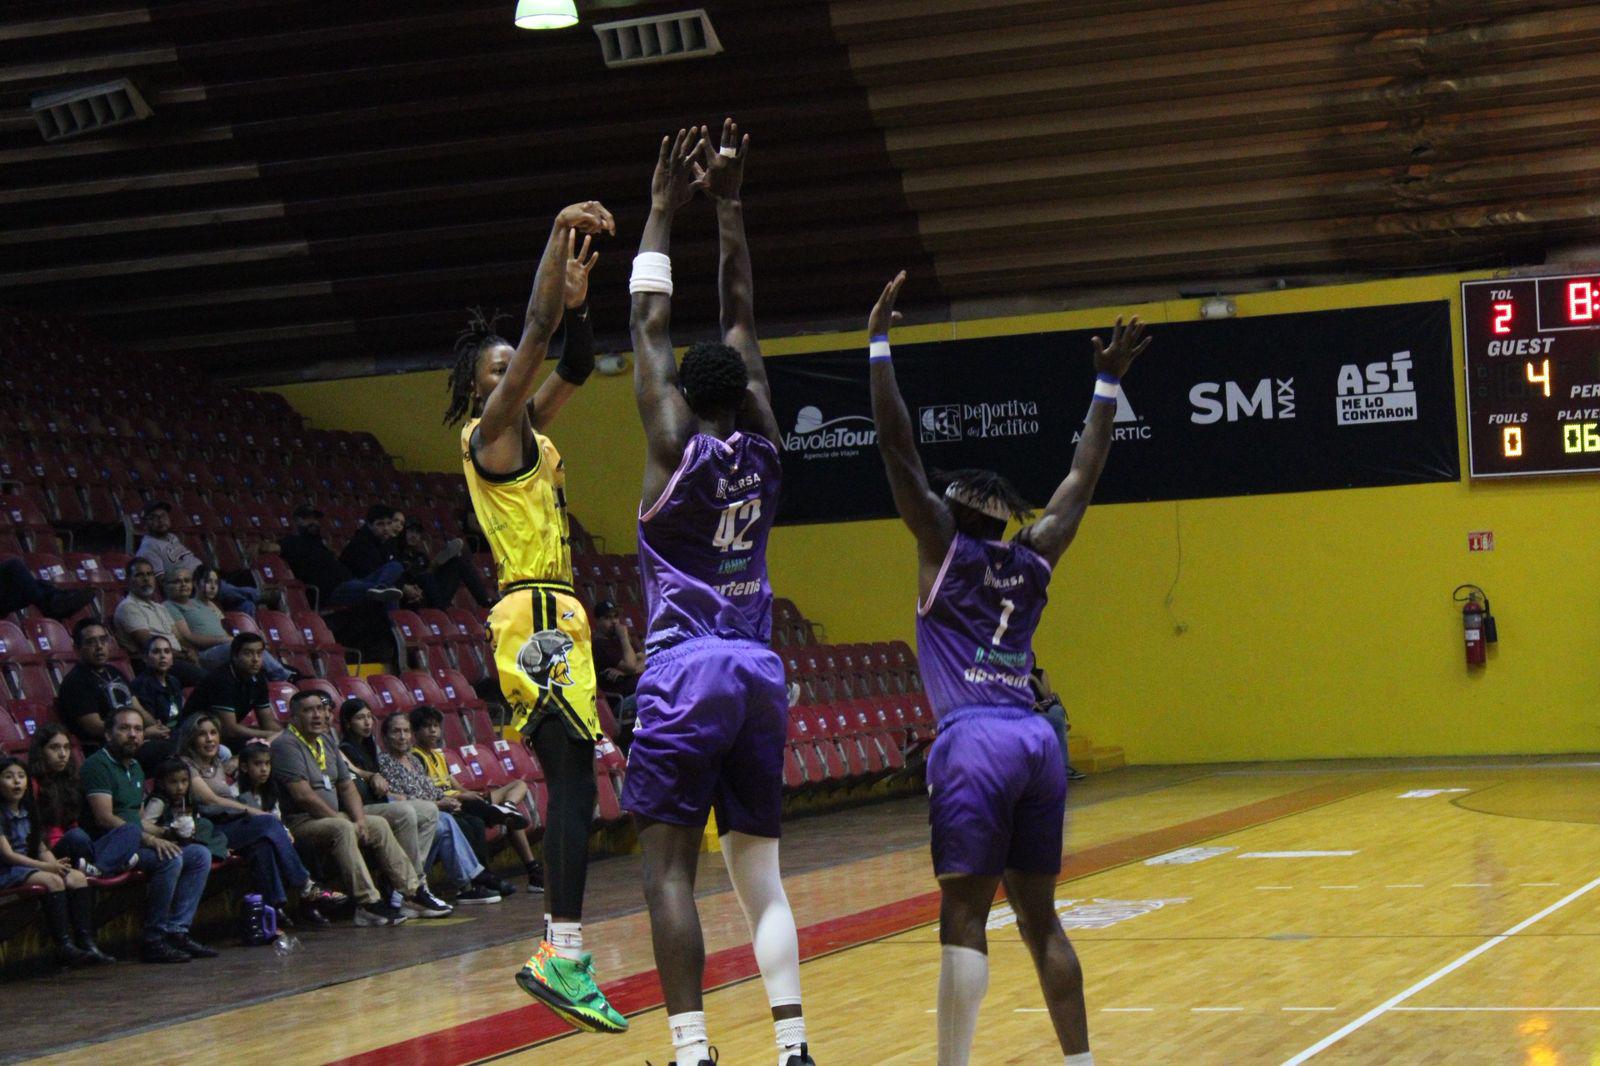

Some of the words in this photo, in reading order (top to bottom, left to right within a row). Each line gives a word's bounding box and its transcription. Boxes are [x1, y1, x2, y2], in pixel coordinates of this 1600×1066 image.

[1490, 290, 1514, 301] TOL
[1494, 303, 1512, 334] 2
[1487, 337, 1556, 357] GUEST
[1337, 350, 1414, 396] ASÍ
[1526, 359, 1551, 398] 4
[1188, 378, 1273, 425] SM
[1341, 399, 1361, 410] ME
[1364, 397, 1384, 409] LO
[1342, 406, 1414, 421] CONTARON
[1488, 412, 1529, 424] FOULS
[1557, 408, 1600, 420] PLAYE
[780, 427, 879, 451] NavolaTour
[1071, 426, 1152, 444] ARTIC
[1503, 426, 1523, 457] 0
[1564, 423, 1600, 453] 06
[712, 499, 762, 553] 42
